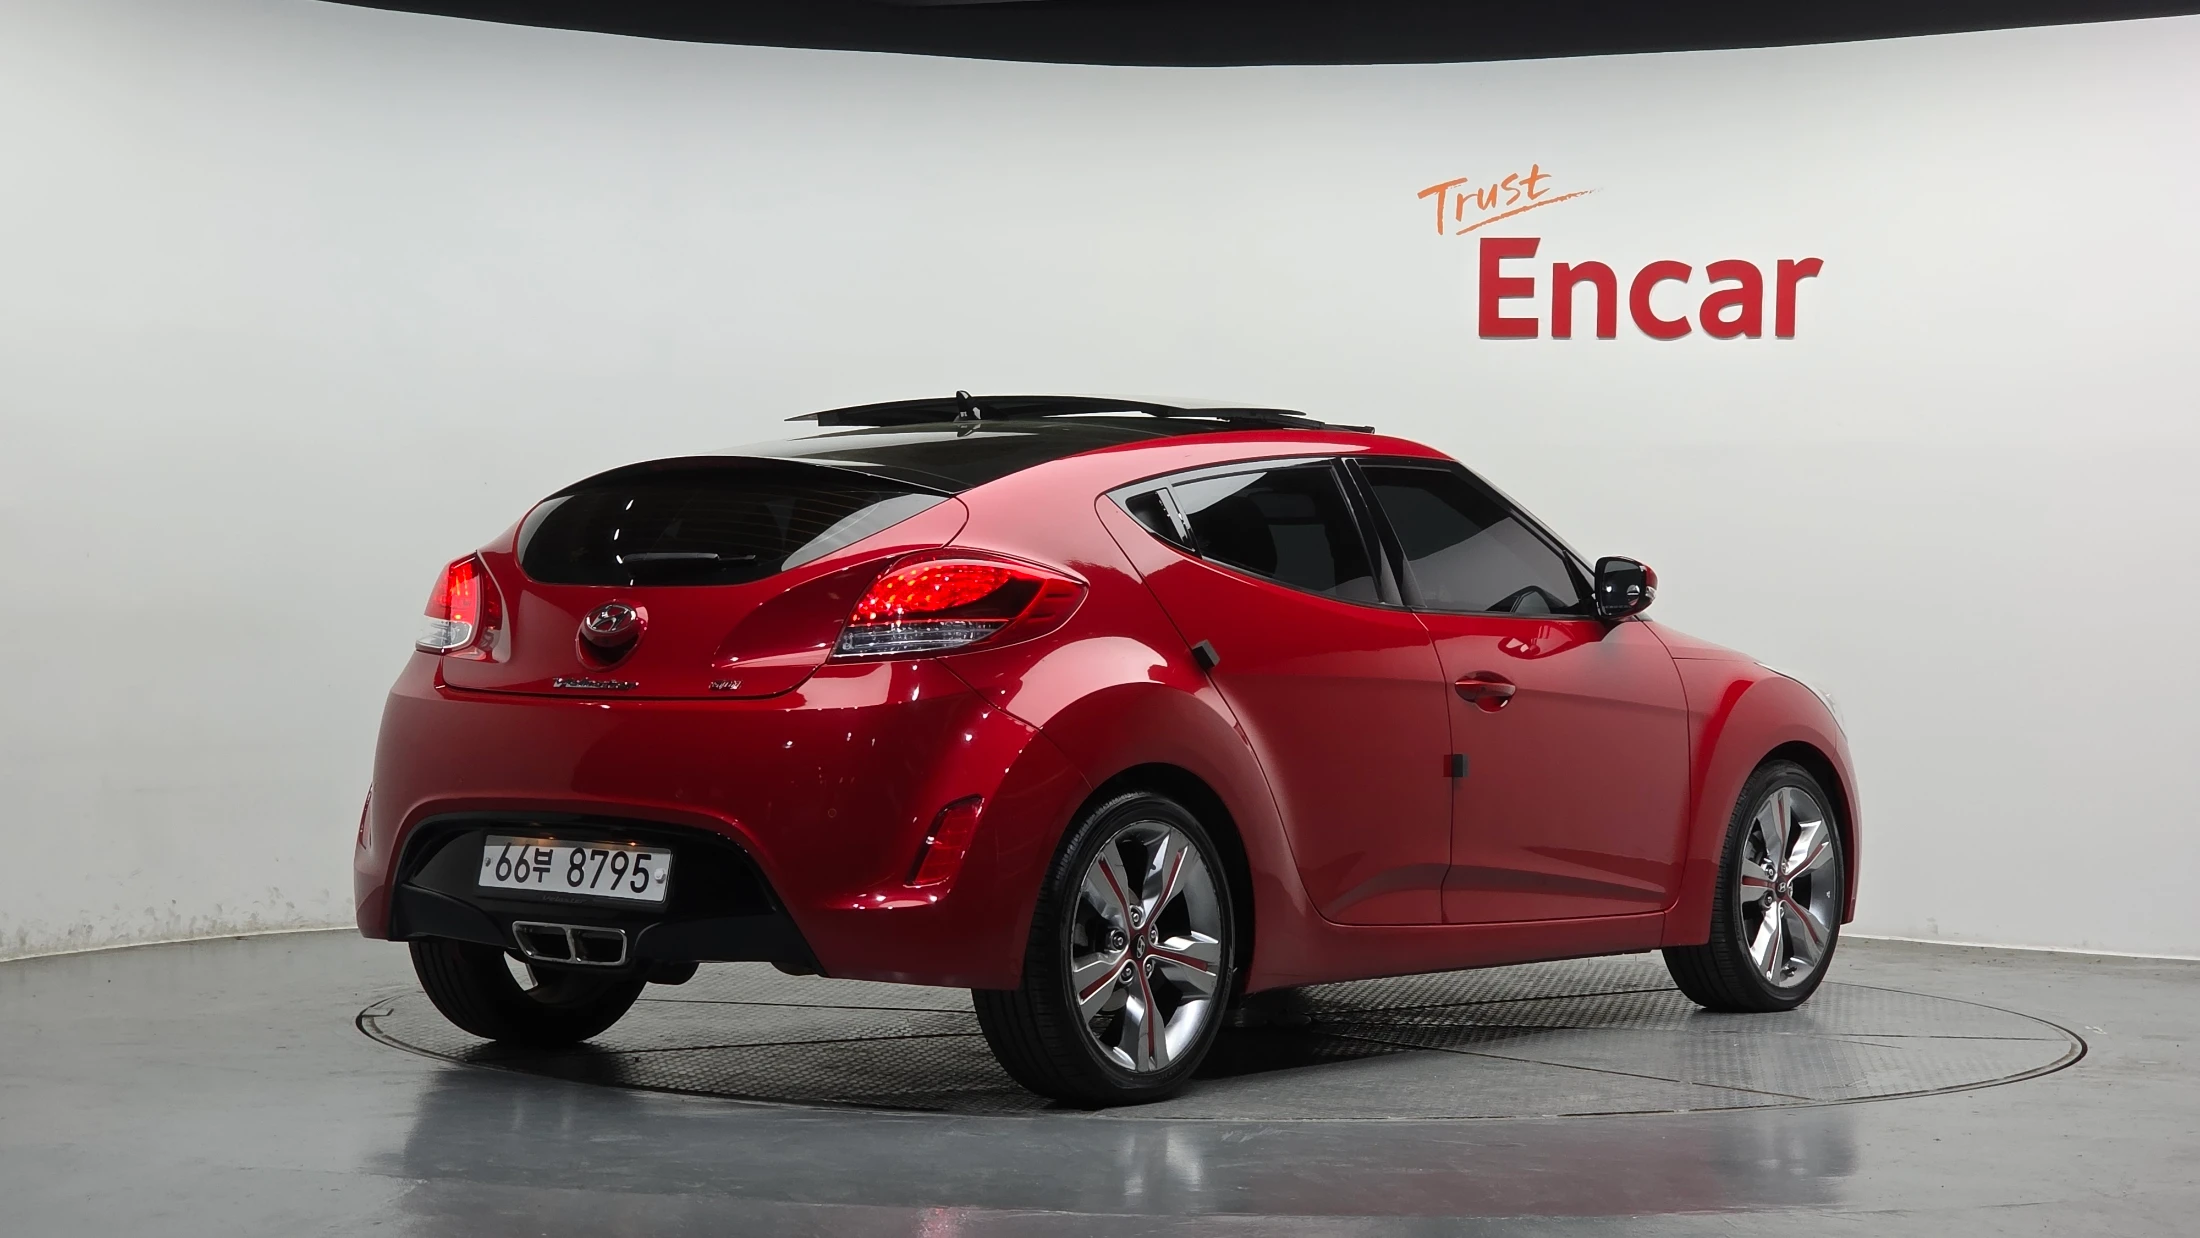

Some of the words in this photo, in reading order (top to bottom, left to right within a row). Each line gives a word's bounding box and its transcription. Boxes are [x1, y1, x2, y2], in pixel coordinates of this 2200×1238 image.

[1417, 163, 1553, 235] Trust
[1478, 237, 1825, 340] Encar
[495, 842, 554, 883] 66부
[566, 846, 652, 894] 8795
